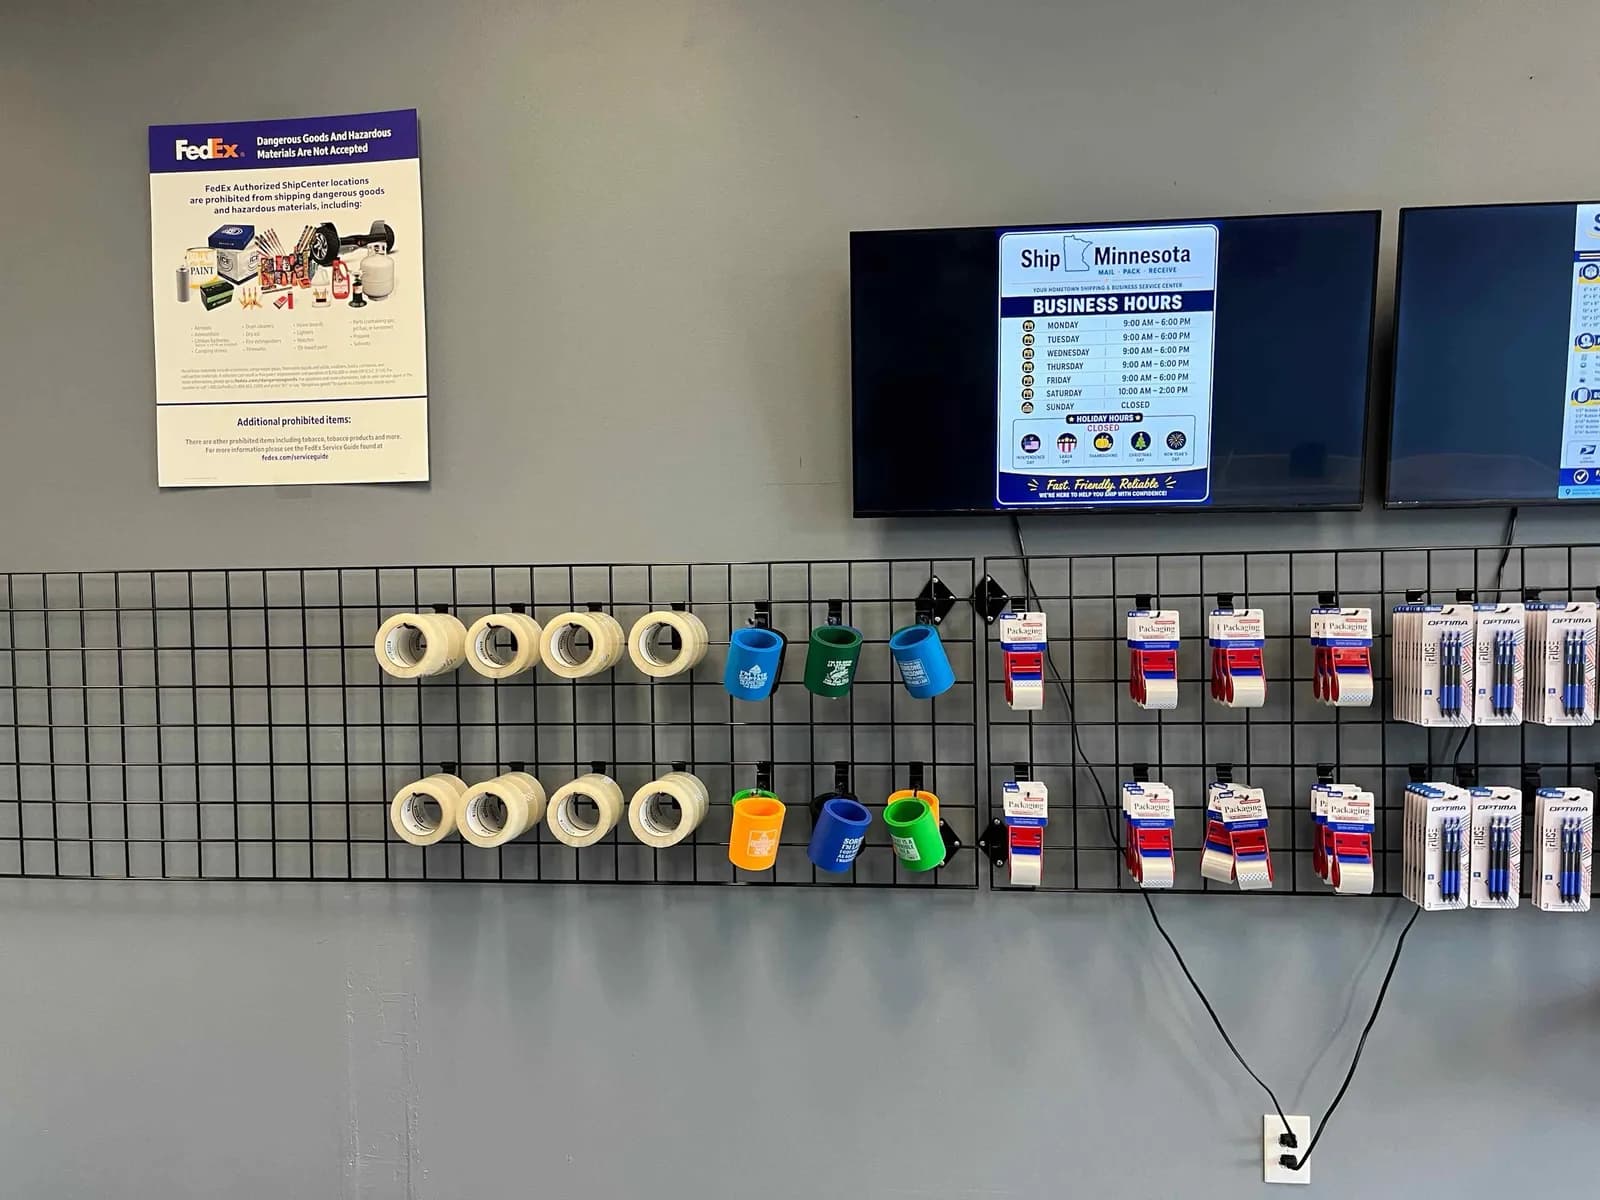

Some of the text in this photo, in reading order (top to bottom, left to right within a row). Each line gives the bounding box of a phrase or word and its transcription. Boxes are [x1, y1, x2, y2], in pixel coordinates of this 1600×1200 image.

[257, 129, 391, 148] Dangerous Goods And Hazardous
[176, 138, 239, 160] FedEx
[257, 143, 368, 159] Materials Are Not Accepted
[233, 182, 280, 192] Authorized
[282, 180, 329, 190] ShipCenter
[331, 178, 369, 186] locations
[205, 195, 250, 206] prohibited
[252, 194, 272, 202] from
[274, 192, 310, 202] shipping
[312, 191, 356, 199] dangerous
[359, 187, 384, 198] goods
[214, 200, 362, 214] and hazardous materials, including:
[1021, 246, 1190, 271] Ship Minnesota
[190, 266, 214, 275] PAINT
[1034, 294, 1182, 314] BUSINESS HOURS
[1047, 321, 1079, 329] MONDAY
[1161, 318, 1178, 326] 6:00
[1160, 332, 1177, 340] 6:00
[1047, 349, 1089, 357] WEDNESDAY
[1160, 346, 1176, 354] 6:00
[1047, 362, 1084, 370] THURSDAY
[1046, 376, 1071, 384] FRIDAY
[1046, 389, 1082, 397] SATURDAY
[1118, 387, 1138, 395] 10:00
[237, 415, 351, 428] Additional prohibited items:
[1077, 414, 1134, 423] HOLIDAY HOURS
[1088, 424, 1120, 432] CLOSED
[229, 438, 259, 446] prohibited
[1047, 479, 1070, 491] Fast.
[1119, 477, 1159, 489] Reliable
[1139, 625, 1175, 633] Packaging
[1224, 624, 1260, 632] Packaging
[1330, 622, 1367, 631] Packaging
[1425, 643, 1435, 661] FUSE
[1479, 642, 1489, 661] FUSE
[1549, 641, 1559, 660] FUSE
[1009, 801, 1044, 809] Packaging
[1134, 803, 1170, 811] Packaging
[1225, 805, 1262, 813] Packaging
[1332, 806, 1370, 815] Packaging
[1428, 828, 1438, 847] FUSE
[1474, 826, 1484, 845] FUSE
[1546, 828, 1556, 847] FUSE
